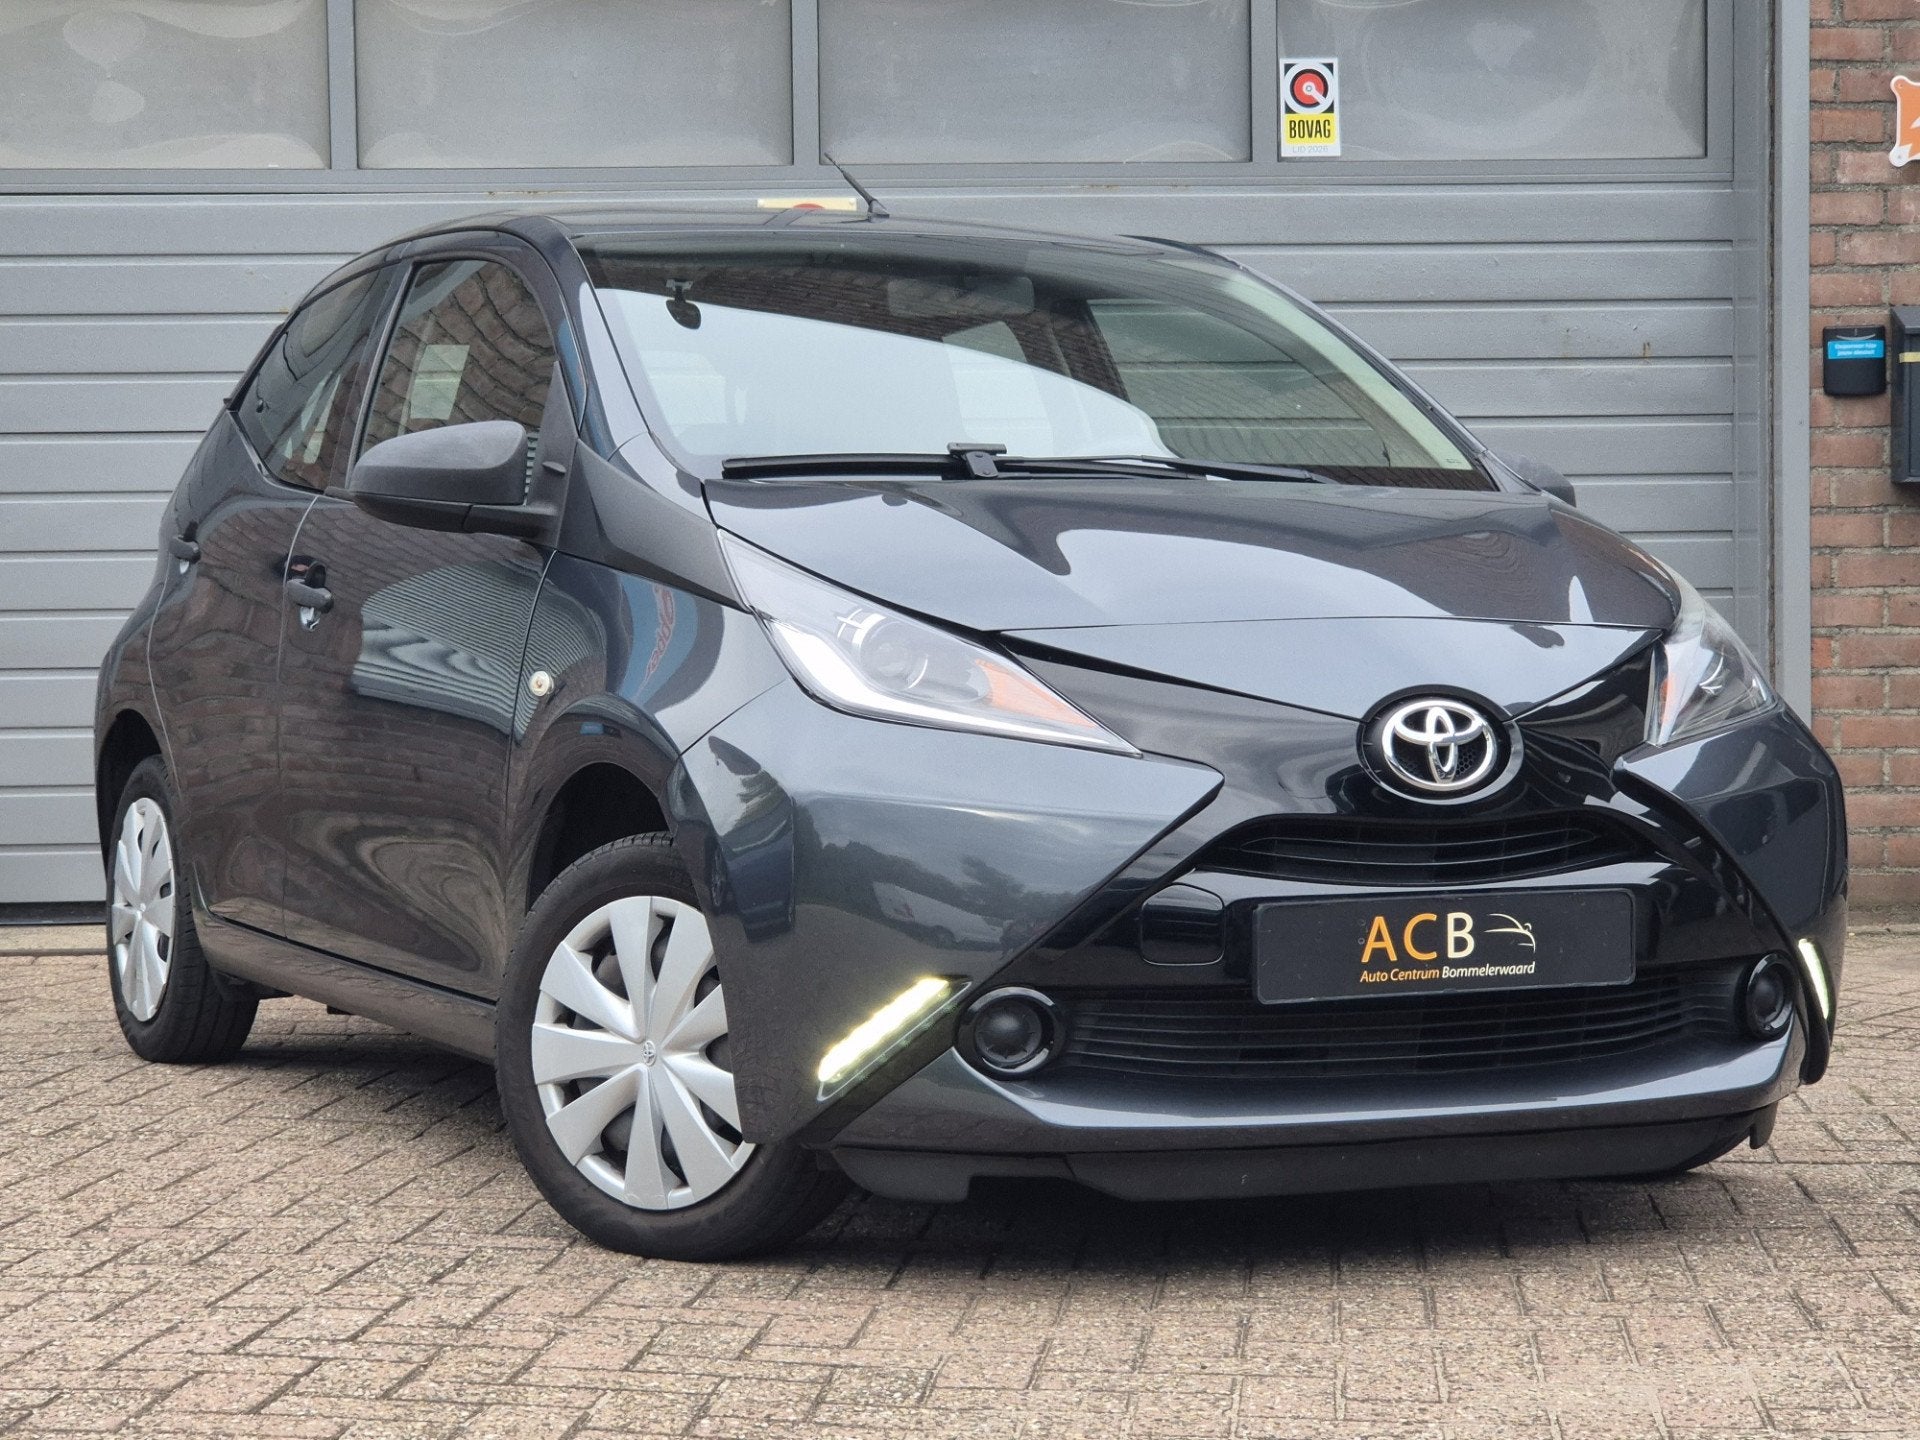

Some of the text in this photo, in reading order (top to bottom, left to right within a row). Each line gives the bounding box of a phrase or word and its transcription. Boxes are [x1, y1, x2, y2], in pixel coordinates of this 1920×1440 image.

[1289, 119, 1331, 139] BOVAG
[1292, 145, 1306, 153] LID
[1361, 912, 1475, 963] ACB
[1359, 961, 1536, 983] Auto Centrum Bommelerwaard
